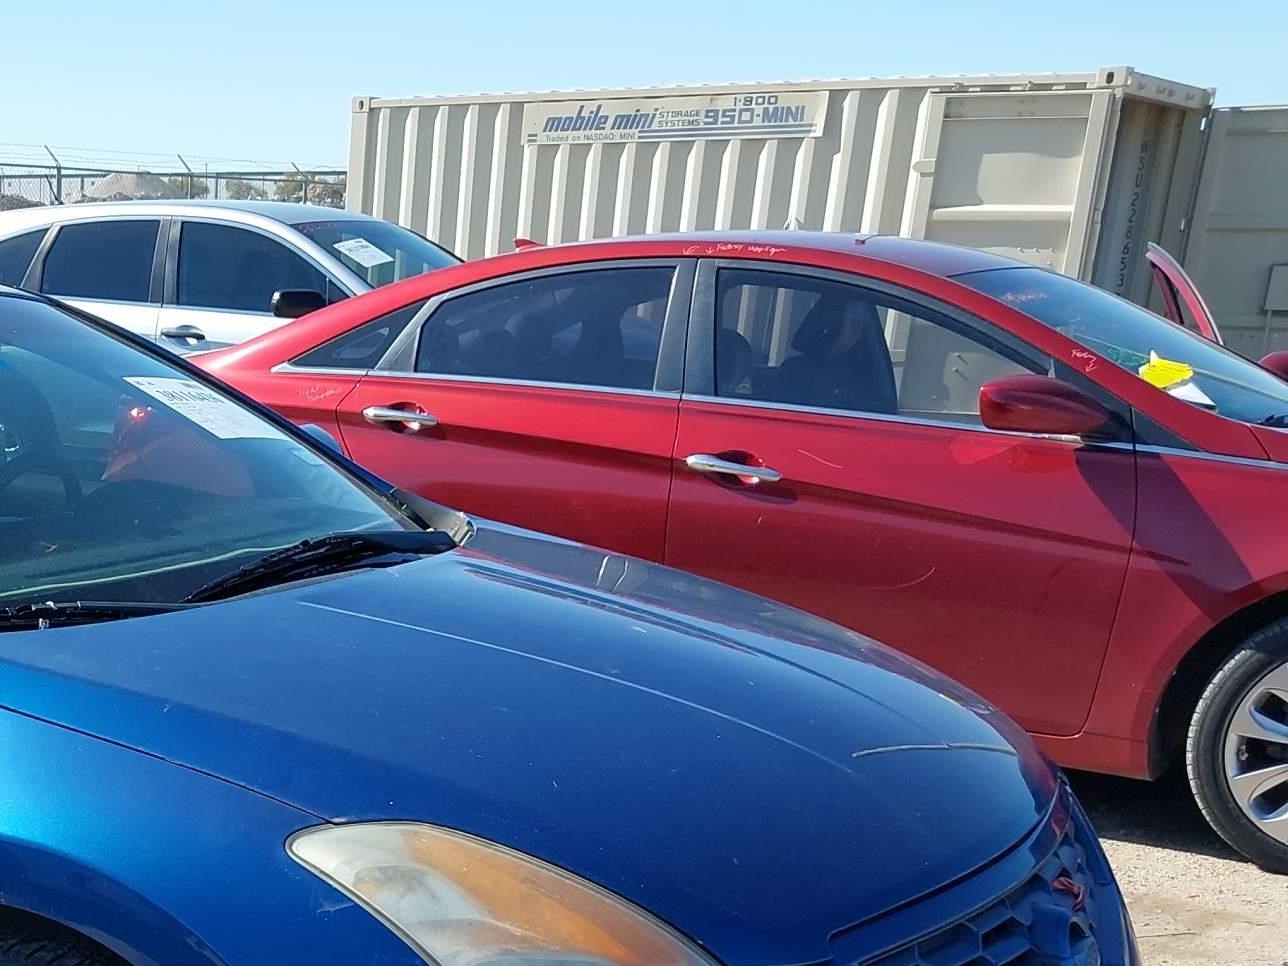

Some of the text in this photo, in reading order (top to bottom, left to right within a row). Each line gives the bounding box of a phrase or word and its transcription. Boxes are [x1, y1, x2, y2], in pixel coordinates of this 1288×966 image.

[542, 104, 660, 133] mobile mini
[658, 109, 702, 120] STORAGE
[657, 118, 701, 128] SYSTEMS
[545, 134, 569, 143] Traded
[619, 132, 637, 140] MINI
